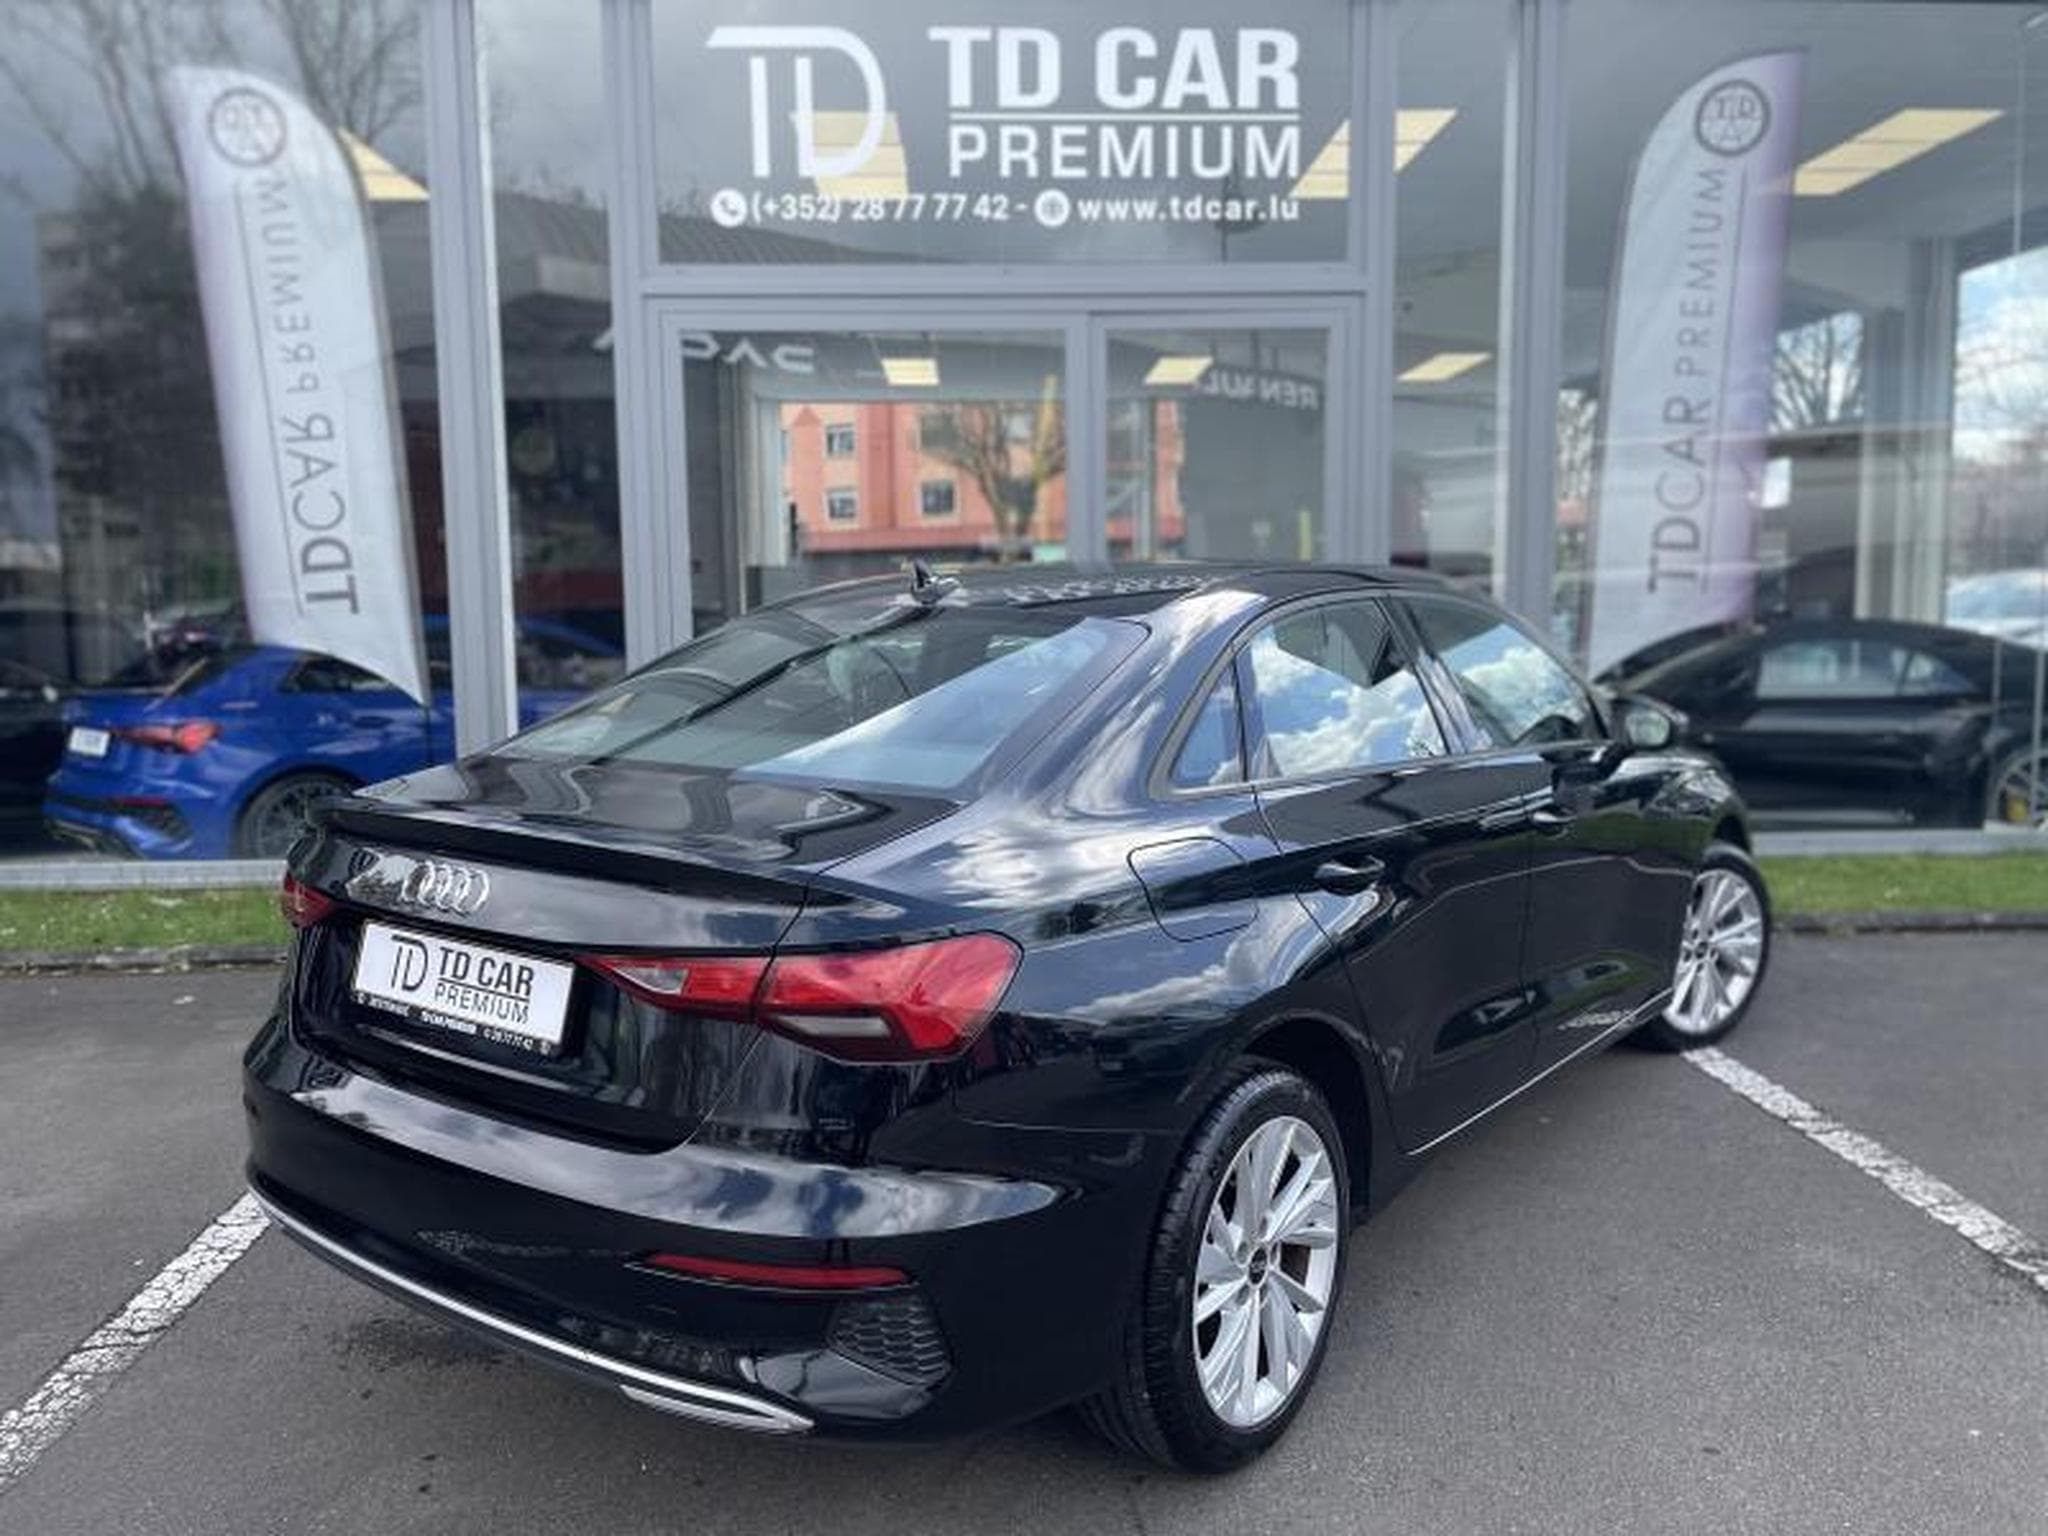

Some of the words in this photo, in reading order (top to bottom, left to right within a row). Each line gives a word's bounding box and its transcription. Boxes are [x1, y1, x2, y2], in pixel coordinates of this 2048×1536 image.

[929, 28, 1061, 108] TD
[1096, 28, 1299, 109] CAR
[950, 125, 1299, 179] PREMIUM
[752, 191, 842, 224] (+352)
[852, 194, 886, 221] 28
[933, 194, 968, 221] 77
[972, 193, 1010, 221] 42
[1077, 194, 1299, 221] www.tdcar.lu
[1673, 166, 1726, 389] PREMIUM
[1646, 391, 1711, 594] TDCAR
[438, 947, 471, 981] TD
[477, 957, 535, 996] CAR
[433, 982, 530, 1025] PREMIUM
